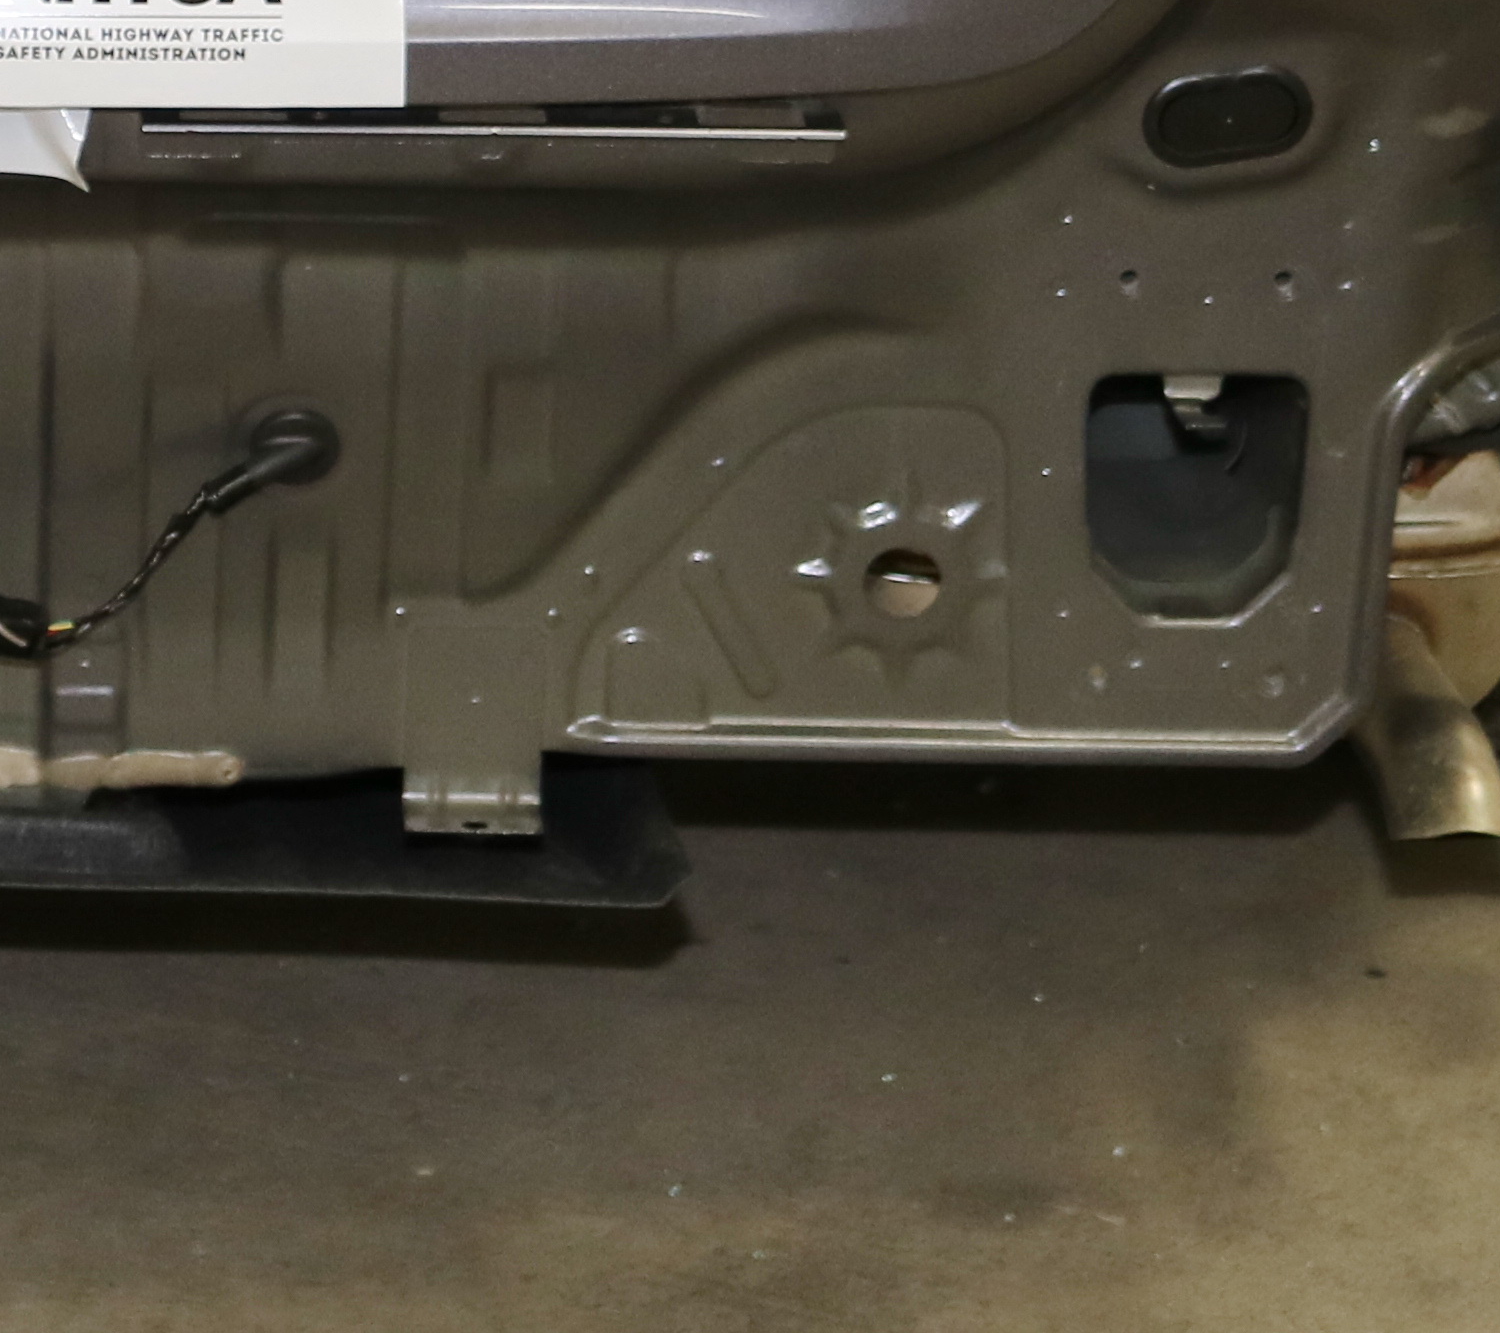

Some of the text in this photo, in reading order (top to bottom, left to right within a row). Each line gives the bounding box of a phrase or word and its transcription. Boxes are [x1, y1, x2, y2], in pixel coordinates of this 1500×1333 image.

[101, 27, 196, 42] HIGHWAY
[200, 27, 285, 43] TRAFFIC
[70, 46, 248, 62] ADMINISTRATION
